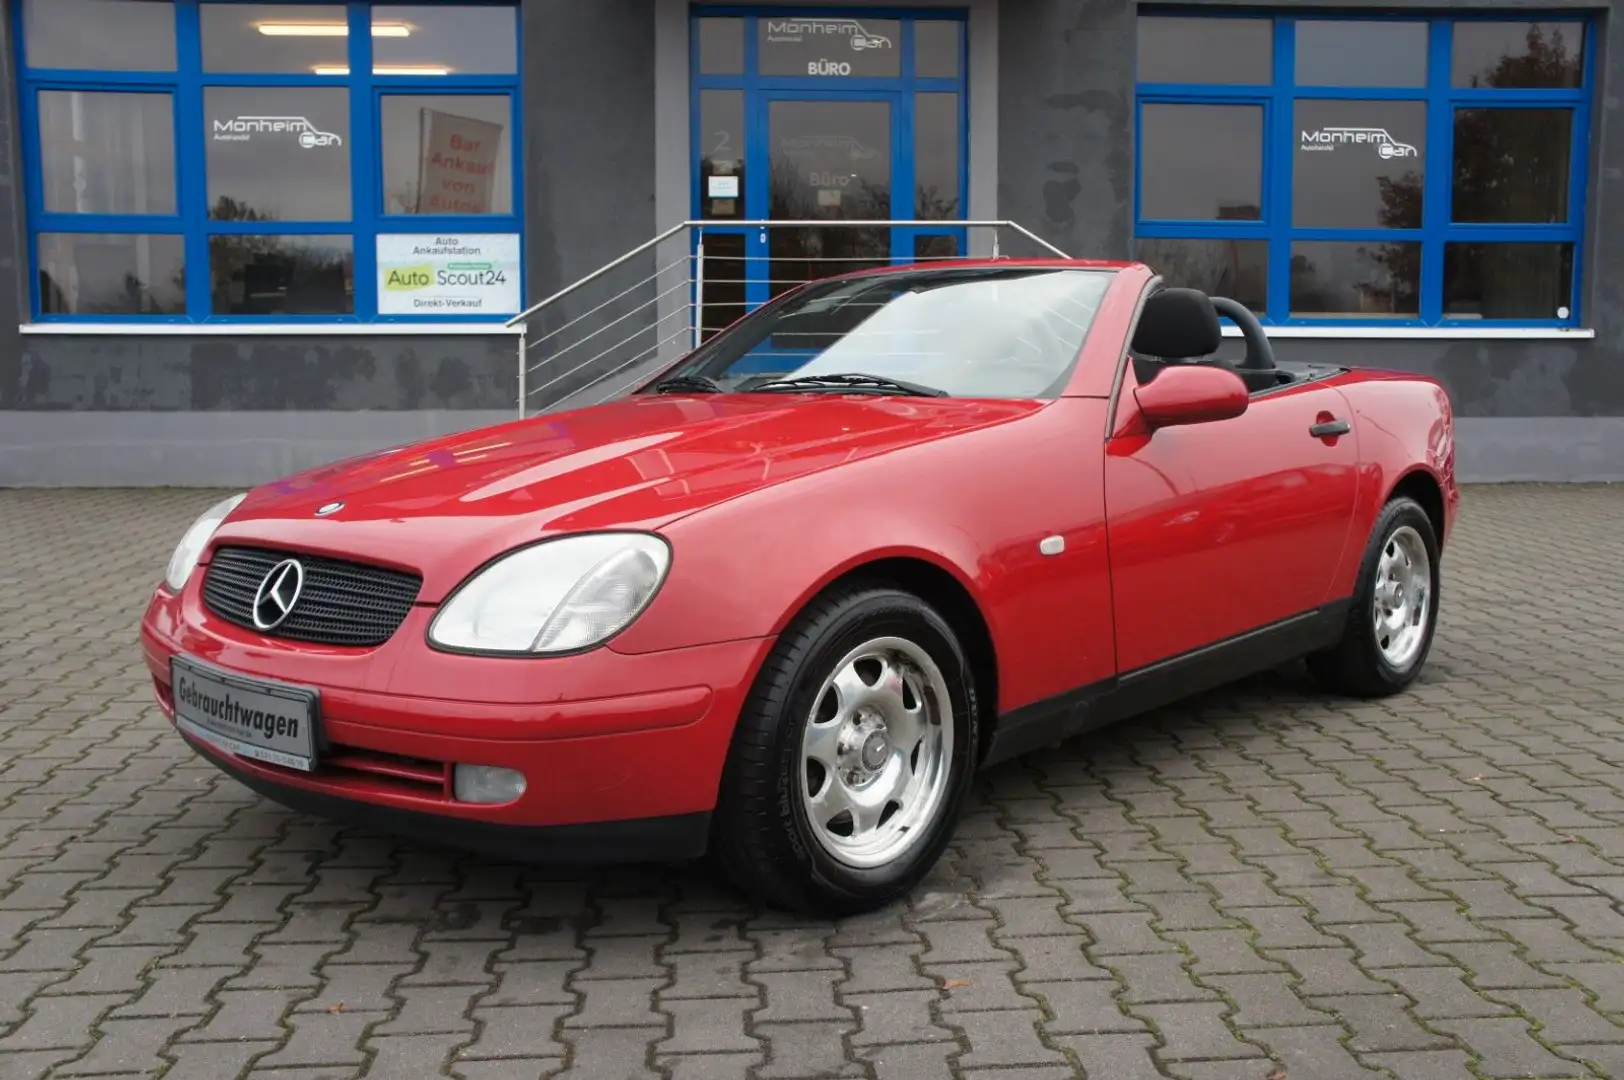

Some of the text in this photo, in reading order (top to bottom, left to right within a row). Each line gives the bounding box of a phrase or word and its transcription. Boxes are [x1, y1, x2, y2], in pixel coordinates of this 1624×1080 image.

[768, 21, 858, 34] Monheim
[808, 58, 850, 75] BÜRO
[213, 119, 306, 132] Monheim
[450, 133, 482, 152] Bar
[1301, 130, 1386, 143] Monheim
[441, 178, 475, 195] von
[435, 236, 459, 246] Auto
[412, 246, 481, 255] Ankaufstation
[387, 269, 507, 286] Auto Scout24
[413, 298, 482, 308] Direkt-Verkauf
[178, 676, 299, 739] Gebrauchtwagen
